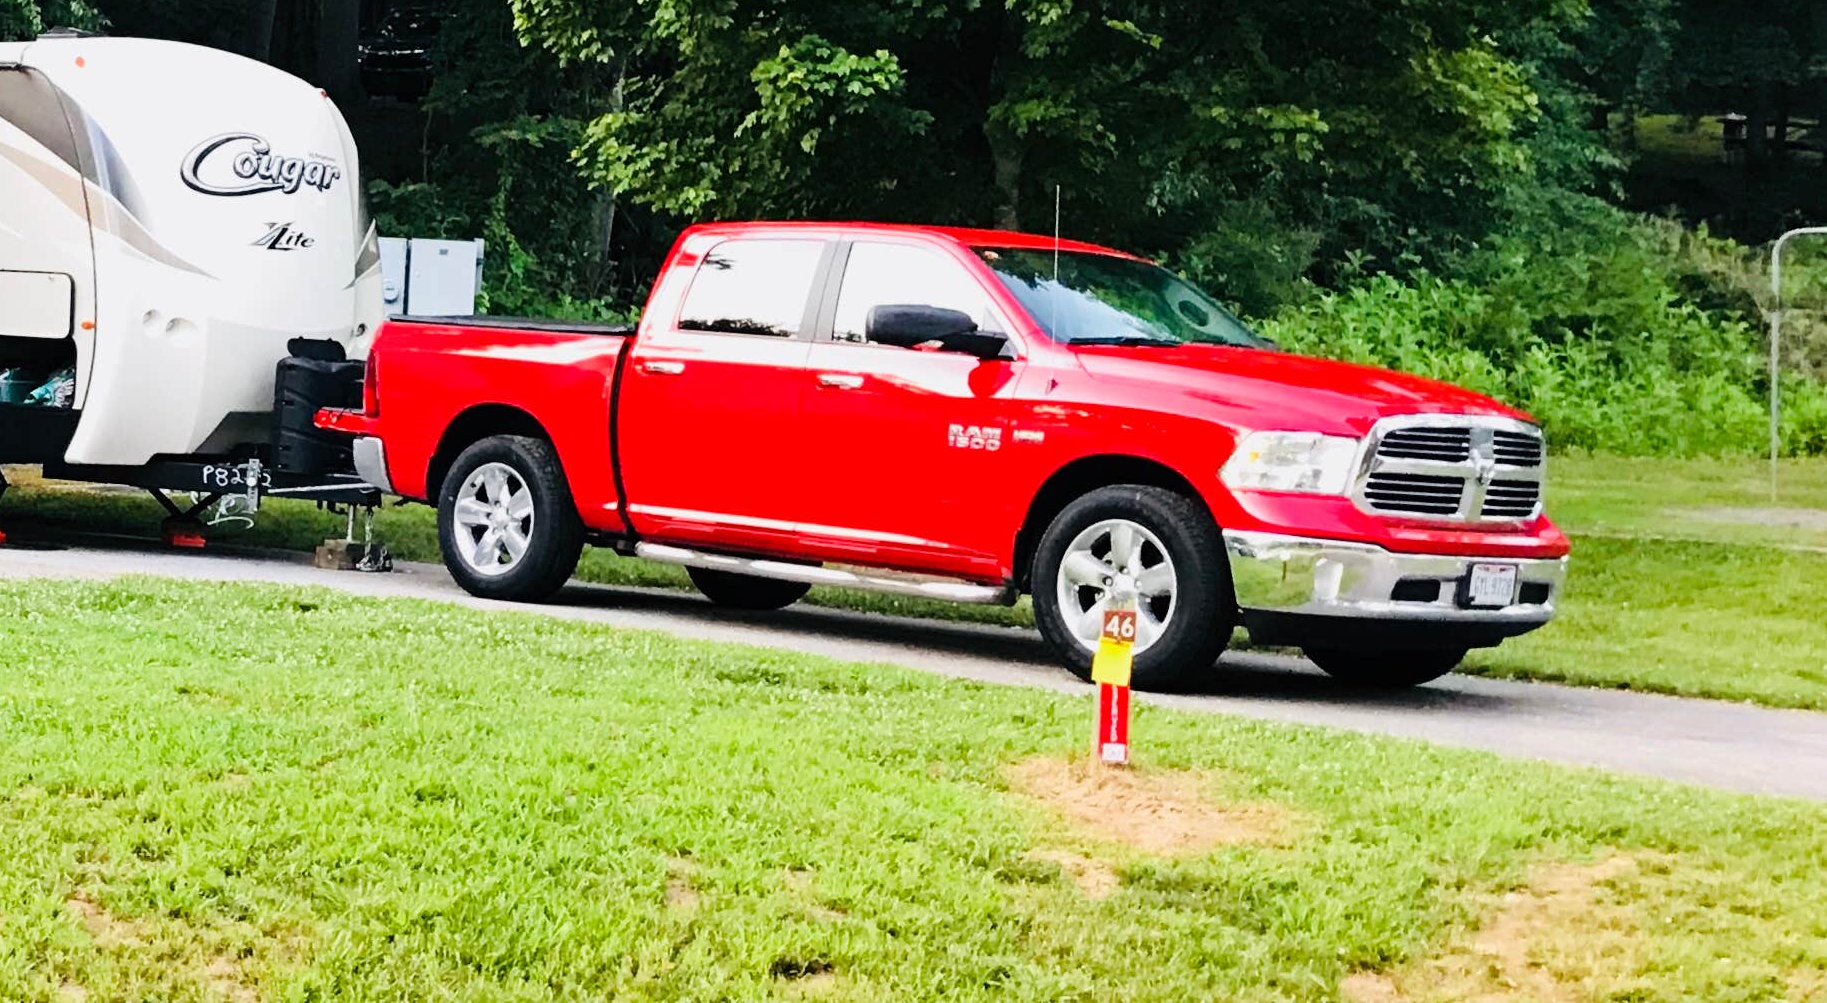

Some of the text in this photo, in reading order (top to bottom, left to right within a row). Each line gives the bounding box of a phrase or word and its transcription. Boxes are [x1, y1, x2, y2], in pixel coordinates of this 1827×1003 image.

[180, 132, 340, 196] Cougar
[948, 423, 1002, 439] RAM
[948, 435, 1001, 451] 1500
[203, 465, 272, 487] P822
[1105, 615, 1134, 638] 46
